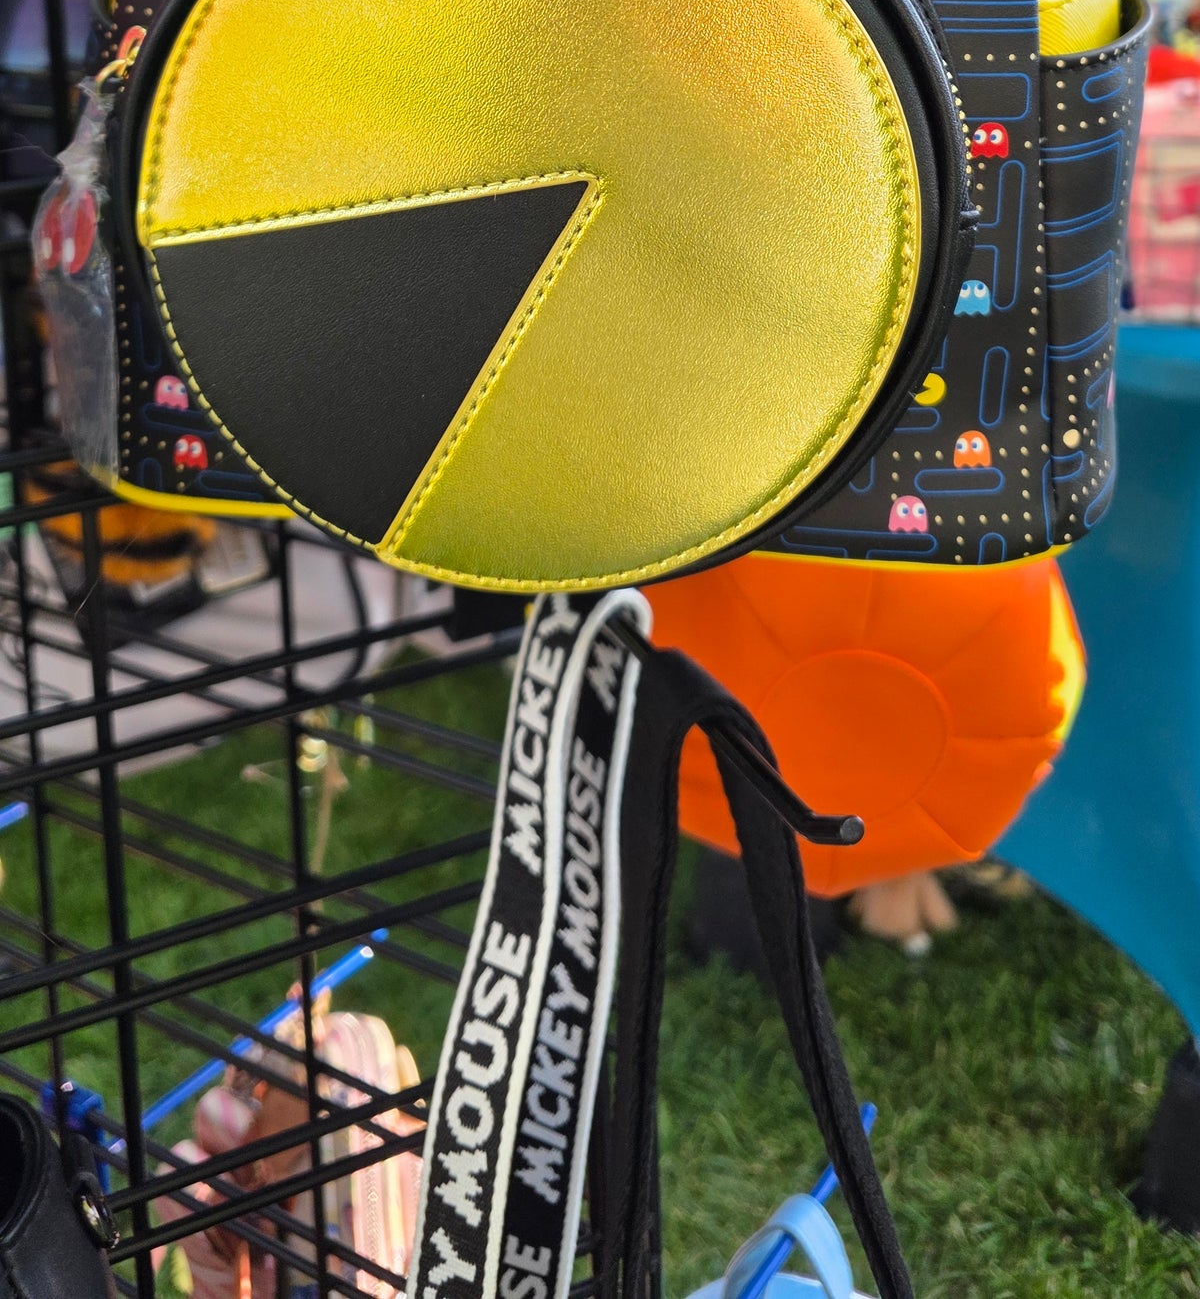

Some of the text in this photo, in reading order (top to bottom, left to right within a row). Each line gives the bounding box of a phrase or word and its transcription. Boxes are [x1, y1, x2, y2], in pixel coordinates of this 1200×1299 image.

[434, 921, 532, 1228] MOUSE
[503, 592, 580, 876] MICKEY
[514, 962, 589, 1204] MICKEY
[556, 736, 606, 971] MOUSE
